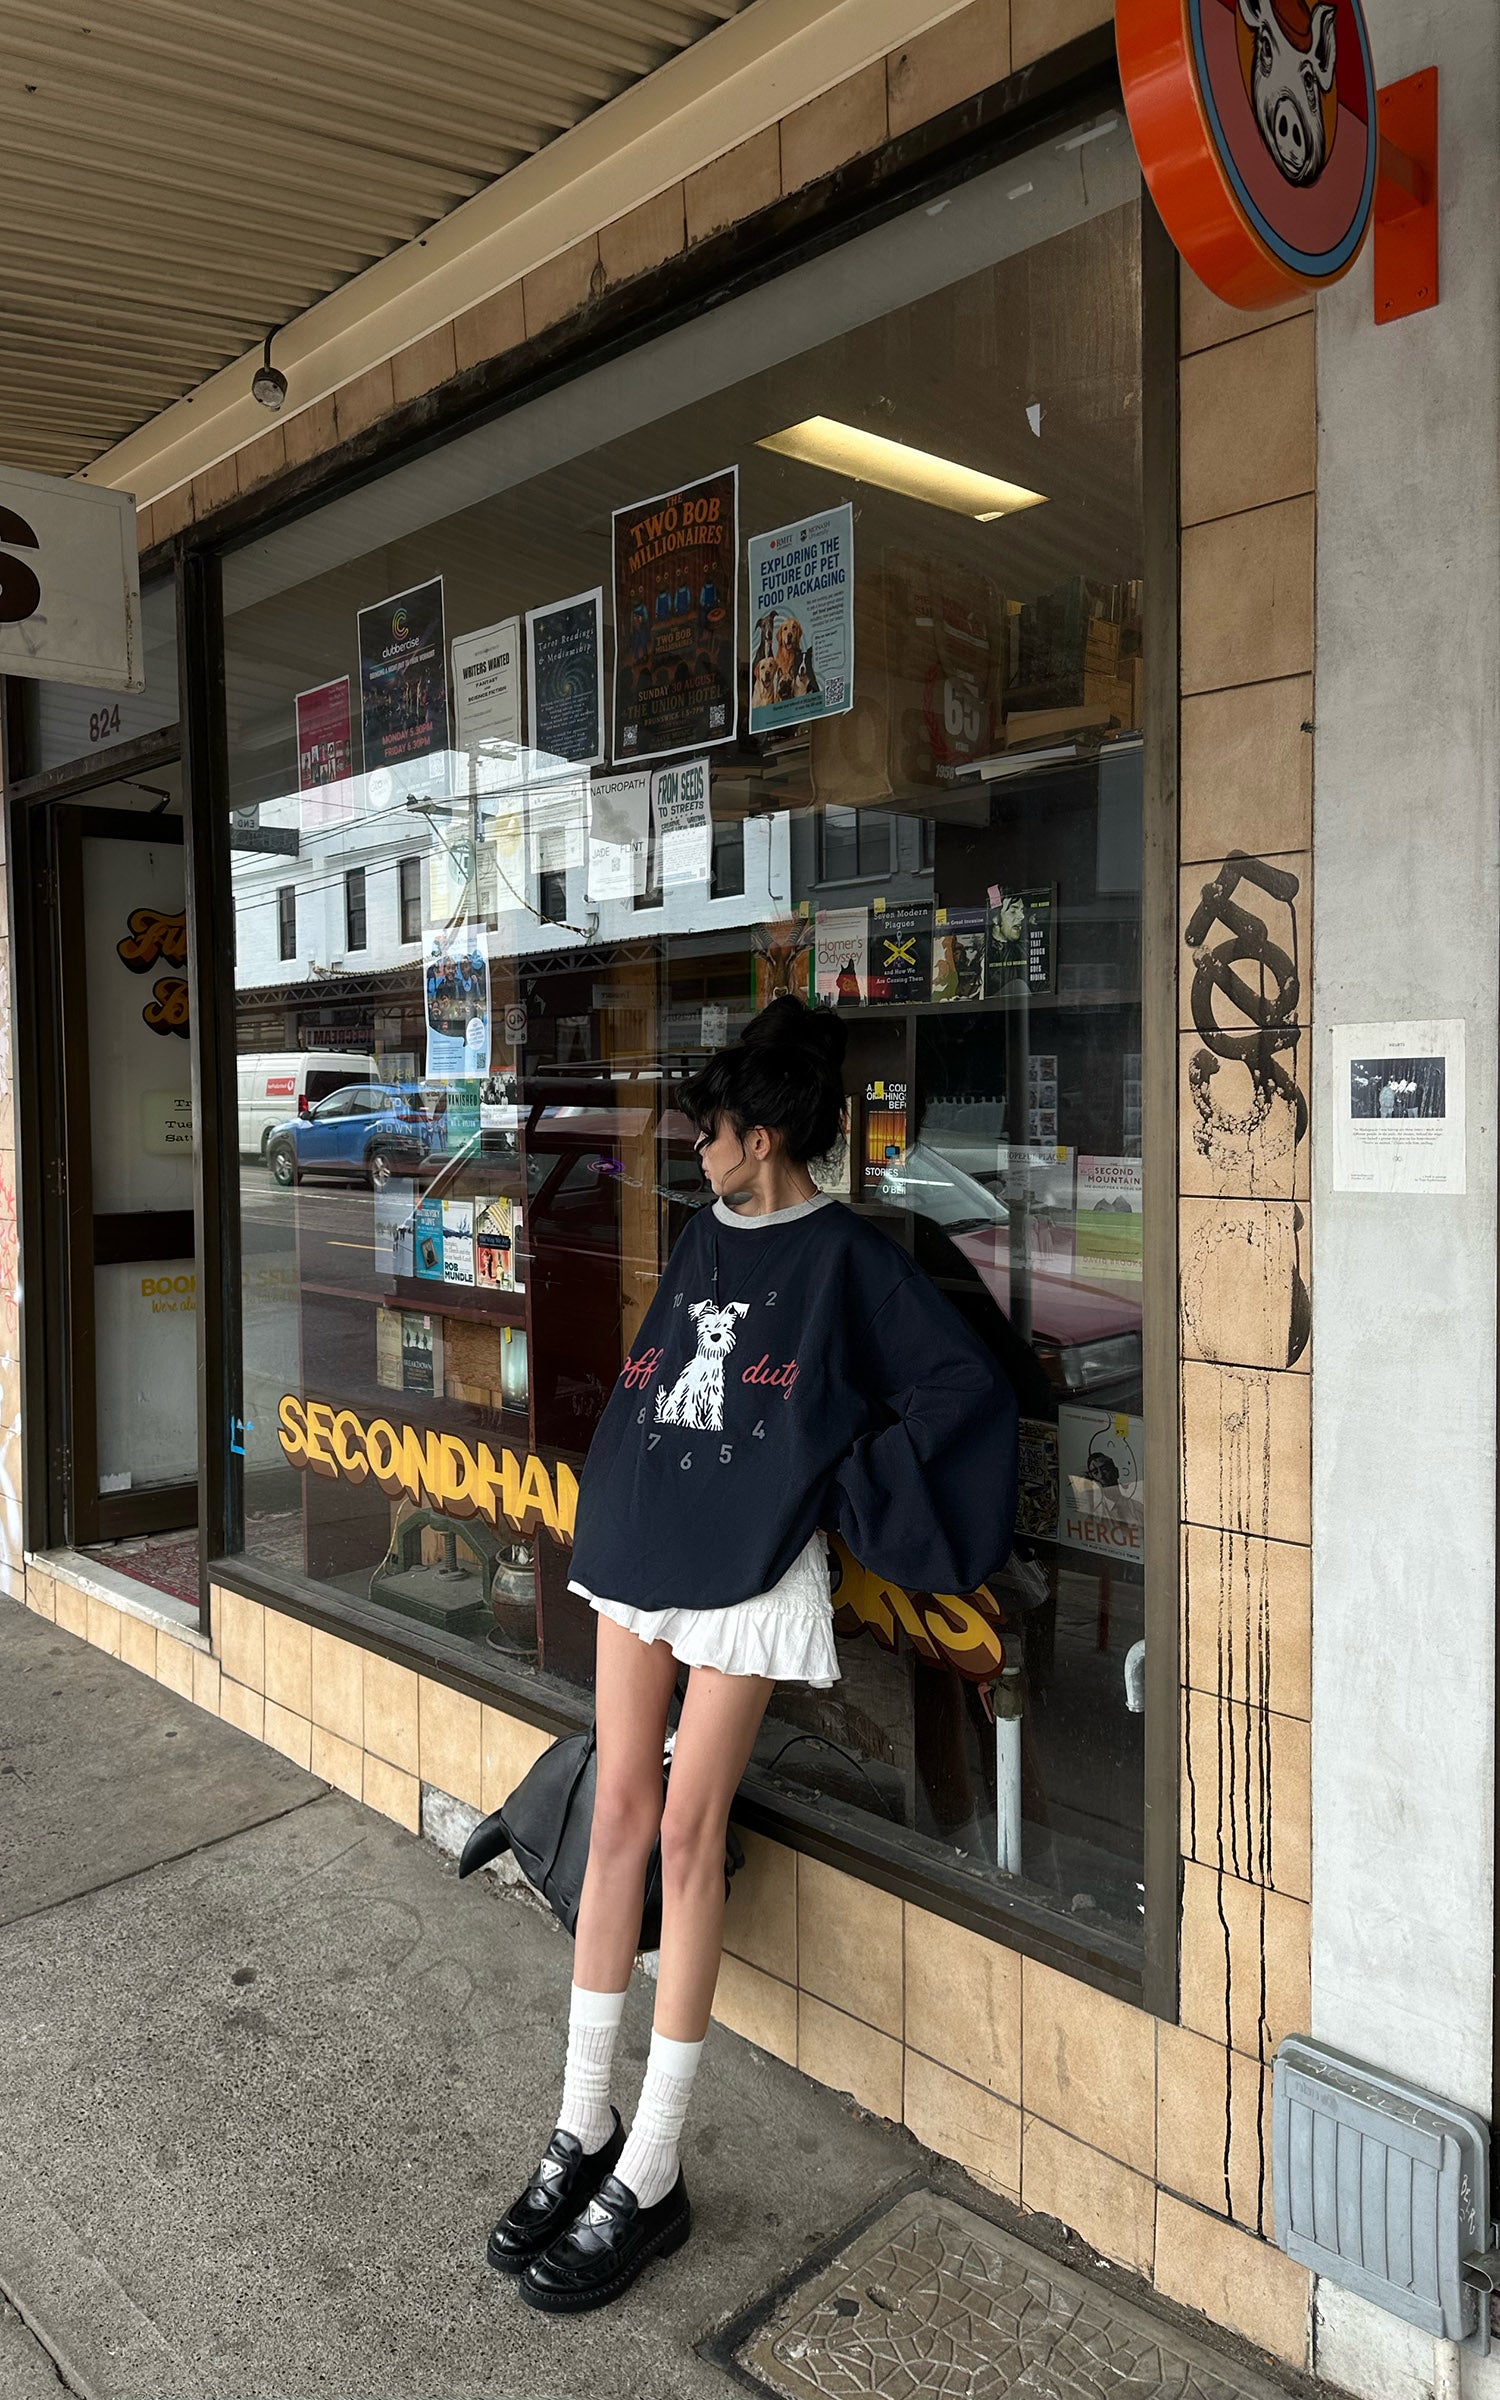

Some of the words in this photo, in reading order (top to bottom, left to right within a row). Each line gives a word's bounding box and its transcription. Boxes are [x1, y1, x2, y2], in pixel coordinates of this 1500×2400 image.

[666, 493, 683, 507] THE
[630, 507, 678, 548] TWO
[682, 497, 721, 527] BOB
[628, 525, 723, 576] MILLIONAIRES
[761, 544, 817, 576] EXPLORING
[820, 536, 840, 555] THE
[762, 566, 801, 592] FUTURE
[804, 561, 817, 578] OF
[820, 553, 840, 573] PET
[758, 588, 784, 609] FOOD
[787, 568, 845, 600] PACKAGING
[462, 661, 487, 680] WRITERS
[487, 652, 510, 671] WANTED
[475, 676, 498, 688] FANTASY
[488, 685, 507, 696] FICTION
[638, 684, 670, 702] SUNDAY
[684, 672, 717, 691] AUGUST
[627, 703, 648, 720] THE
[651, 693, 686, 713] UNION
[688, 684, 722, 705] HOTEL
[89, 703, 121, 742] 824
[381, 729, 409, 745] MONDAY
[384, 742, 406, 758] FRIDAY
[590, 778, 646, 797] NATUROPATH
[657, 772, 679, 805] FROM
[681, 766, 704, 801] SEEDS
[658, 806, 668, 818] TO
[670, 800, 704, 815] STREETS
[592, 846, 610, 860] JADE
[620, 841, 644, 854] FLINT
[874, 911, 895, 920] Seven
[897, 908, 928, 918] Modern
[884, 921, 915, 930] Plagues
[818, 937, 863, 951] Homer's
[818, 951, 863, 965] Odyssey
[866, 1083, 872, 1092] A
[888, 1101, 907, 1110] BEF
[376, 1124, 413, 1135] DOWN
[1087, 1175, 1141, 1185] MOUNTAIN
[1094, 1167, 1134, 1176] SECOND
[444, 1262, 459, 1272] ROB
[444, 1271, 473, 1283] MUNDLE
[672, 1292, 683, 1309] 10
[765, 1291, 777, 1306] 2
[404, 1359, 433, 1371] BREAKDOWN
[620, 1347, 664, 1390] off
[741, 1354, 800, 1400] duty
[637, 1407, 646, 1424] 8
[752, 1420, 766, 1440] 4
[647, 1433, 662, 1451] 7
[680, 1452, 692, 1470] 6
[719, 1444, 733, 1464] 5
[1066, 1519, 1140, 1548] HERGÉ
